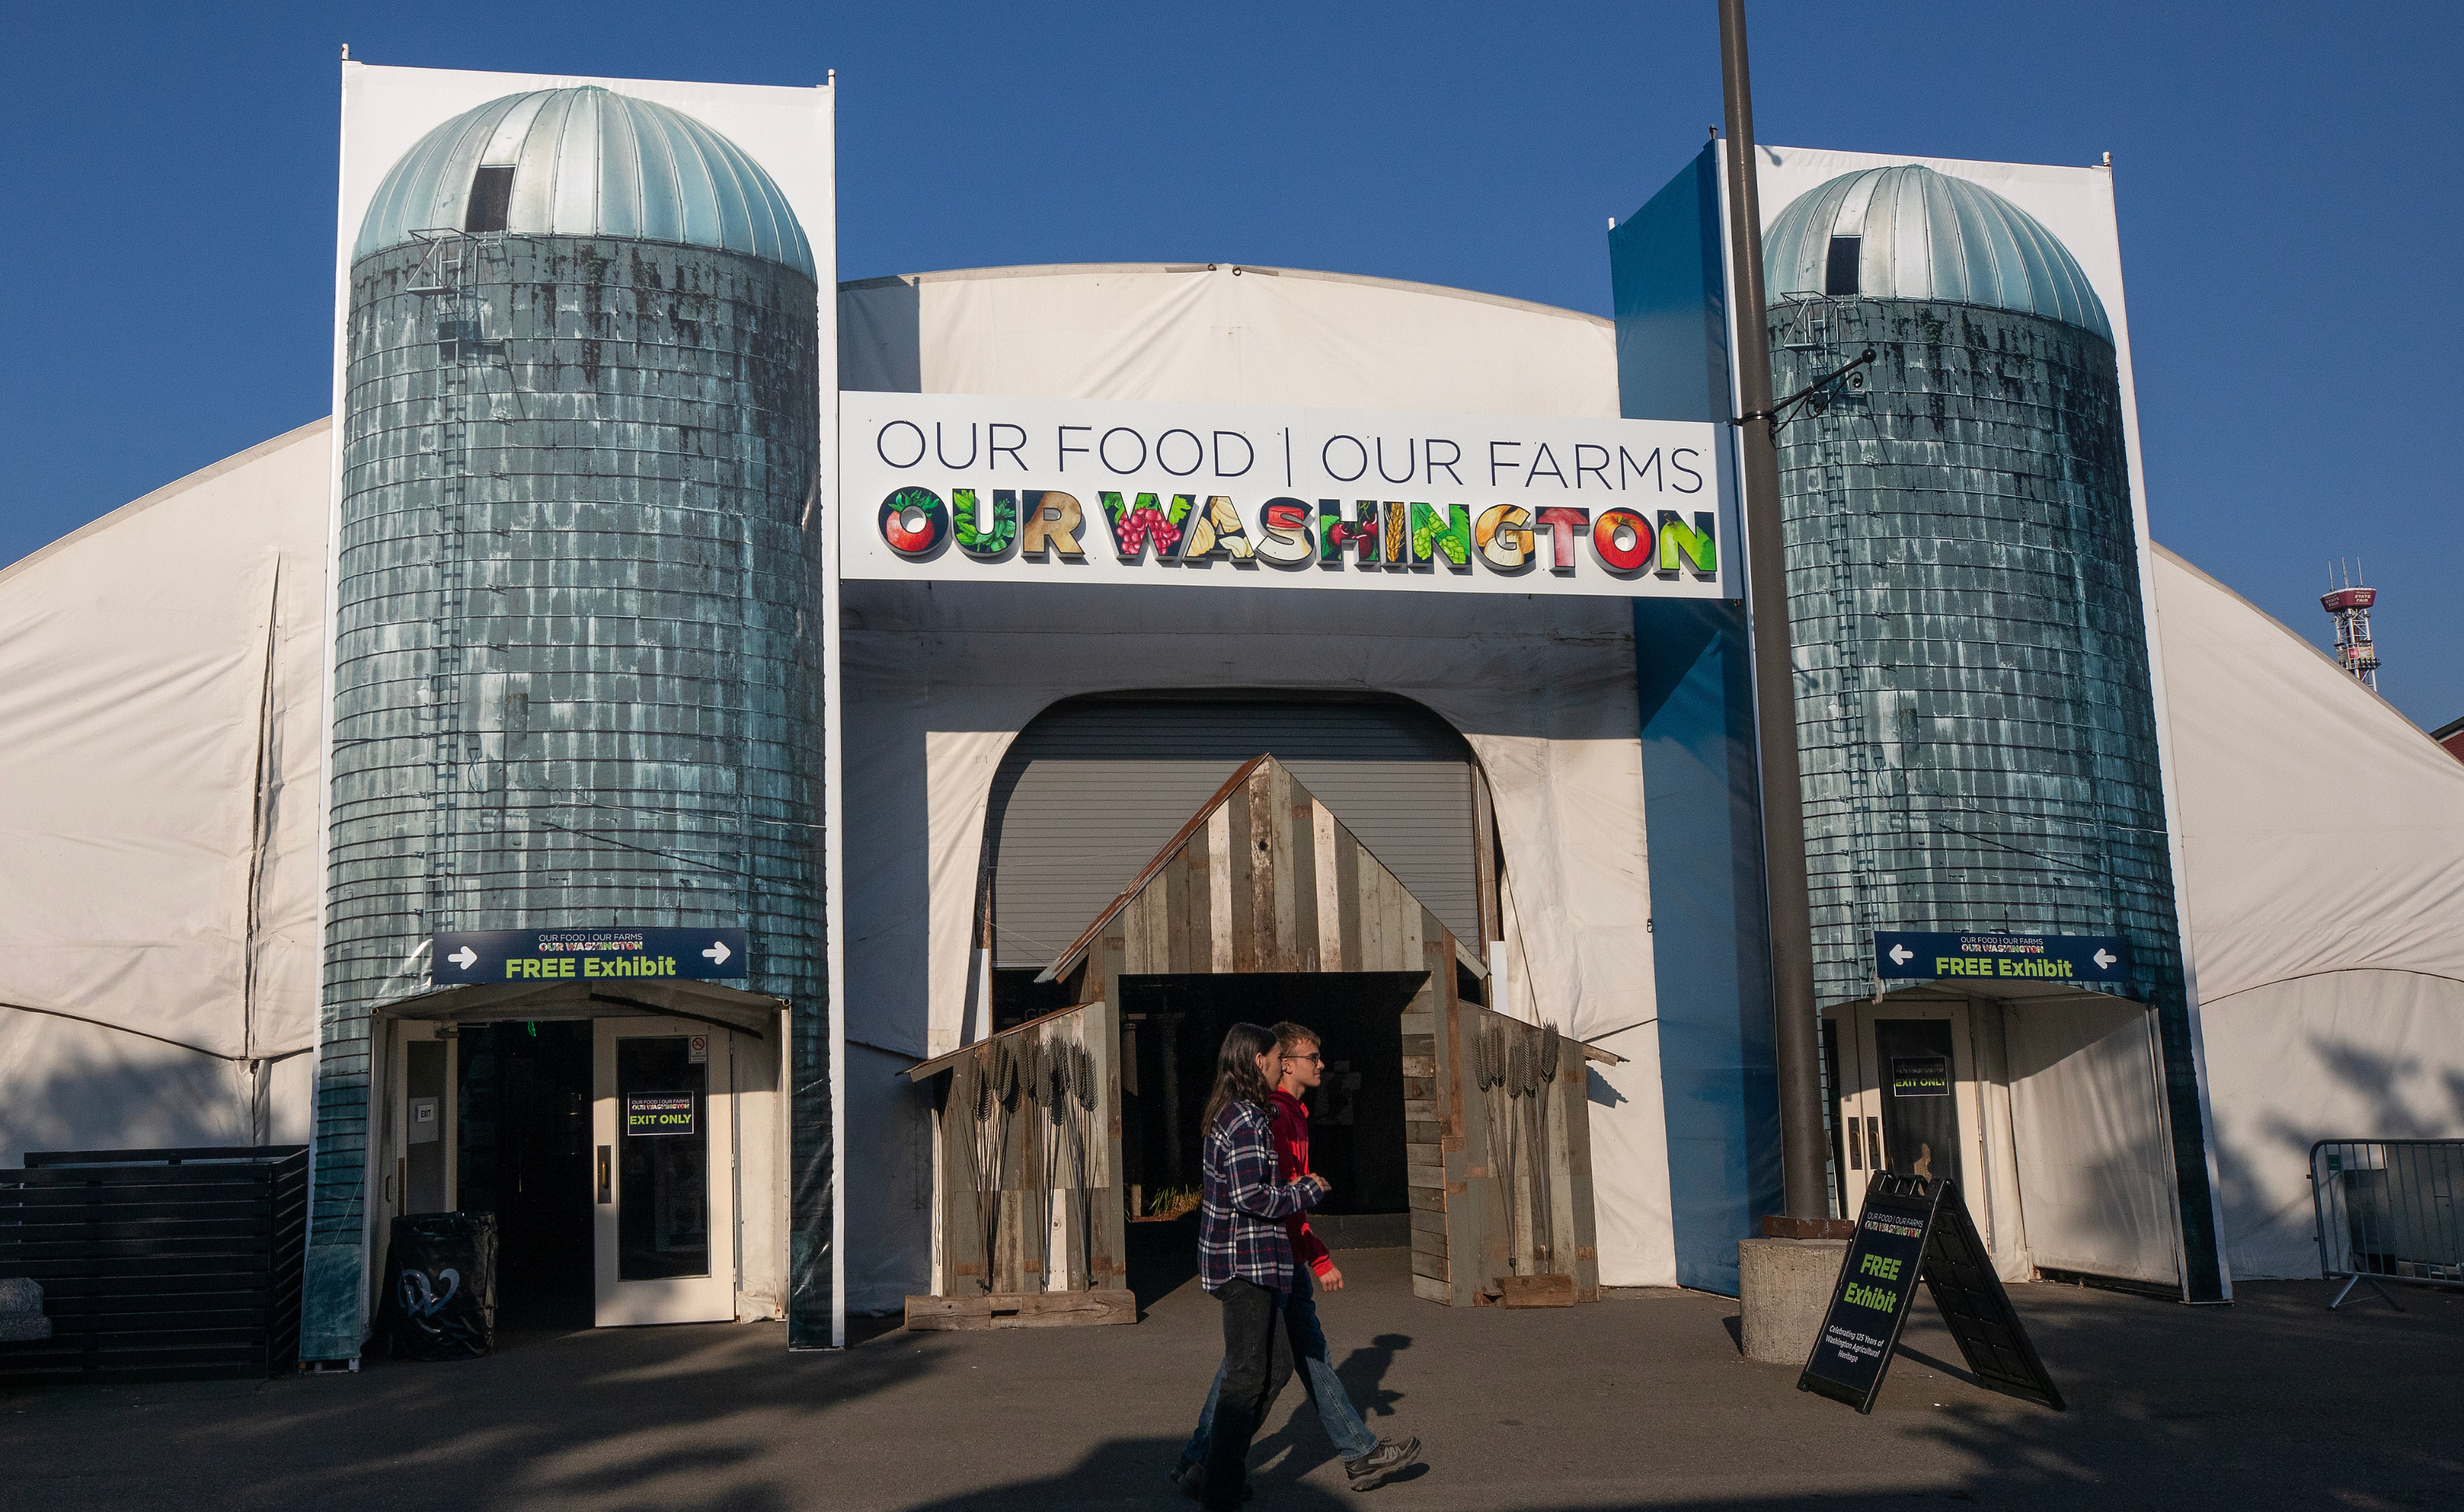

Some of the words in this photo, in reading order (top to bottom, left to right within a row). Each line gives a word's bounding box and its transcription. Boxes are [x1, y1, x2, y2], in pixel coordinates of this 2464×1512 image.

[876, 419, 1029, 471] OUR
[1058, 424, 1255, 478] FOOD
[1321, 434, 1463, 485] OUR
[1489, 441, 1705, 495] FARMS
[876, 484, 1086, 560] OUR
[1095, 491, 1718, 582] WASHINGTON
[539, 942, 564, 951] OUR
[565, 941, 643, 951] WASHINGTON
[1961, 944, 1982, 952] OUR
[1982, 944, 2044, 954] WASHINGTON
[506, 957, 575, 978] FREE
[584, 955, 676, 977] Exhibit
[1936, 957, 1993, 976] FREE
[1999, 957, 2073, 977] Exhibit
[1896, 1078, 1917, 1087] EXIT
[420, 1109, 431, 1118] EXIT
[630, 1115, 657, 1125] EXIT
[659, 1114, 691, 1124] ONLY
[1865, 1220, 1879, 1231] OUR
[1879, 1222, 1922, 1239] WASHINGTON
[1867, 1212, 1879, 1220] OUR
[1879, 1213, 1893, 1222] FOOD
[1896, 1216, 1907, 1225] OUR
[1907, 1218, 1923, 1228] FARMS
[1860, 1253, 1902, 1281] FREE
[1843, 1282, 1897, 1313] Exhibit
[1829, 1325, 1856, 1340] Celebrating
[1856, 1333, 1865, 1342] 125
[1864, 1335, 1877, 1346] Years
[1826, 1334, 1853, 1349] Washington
[1852, 1343, 1880, 1358] Agricultural
[1838, 1349, 1859, 1363] Heritage
